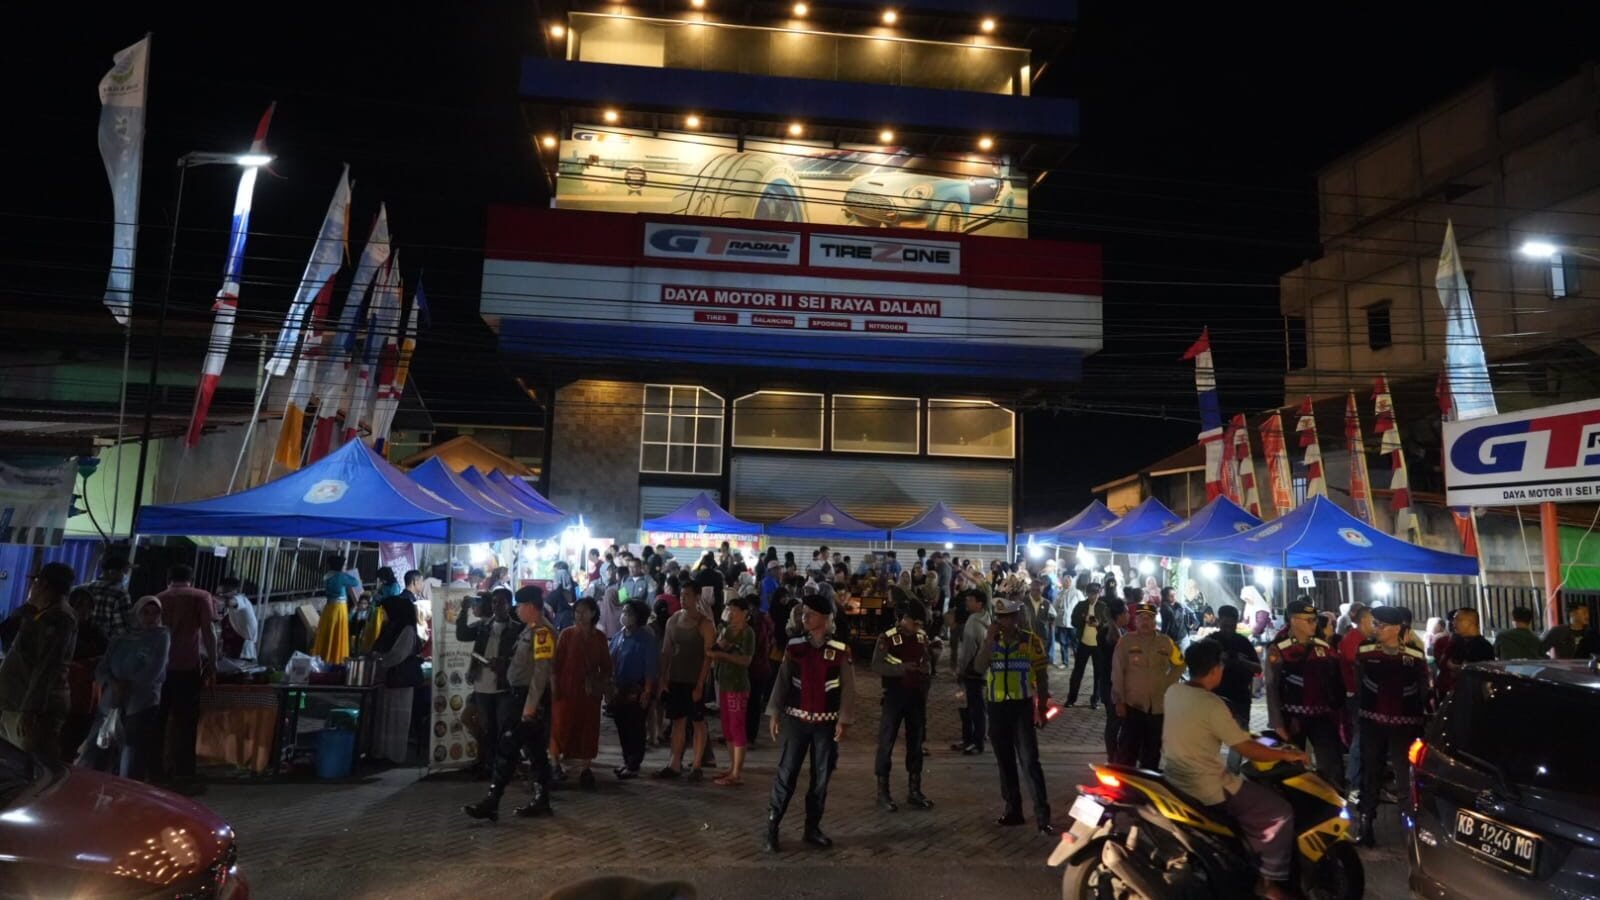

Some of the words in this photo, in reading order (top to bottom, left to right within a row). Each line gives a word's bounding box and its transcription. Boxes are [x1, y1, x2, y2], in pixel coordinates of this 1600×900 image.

[649, 229, 742, 257] GT
[729, 240, 791, 252] RADIAL
[664, 287, 709, 303] DAYA
[714, 290, 777, 307] MOTOR
[781, 294, 793, 307] II
[798, 296, 825, 310] SEI
[830, 297, 875, 312] RAYA
[879, 300, 938, 316] DALAM
[705, 314, 728, 322] TIRES
[867, 323, 905, 332] NITROGEN
[1450, 408, 1600, 475] GT
[1503, 490, 1526, 500] DAYA
[1528, 487, 1563, 498] MOTOR
[1565, 487, 1573, 497] II
[1575, 485, 1592, 496] SEI
[1302, 575, 1309, 584] 6
[1458, 815, 1474, 835] KB
[1480, 823, 1511, 851] 1246
